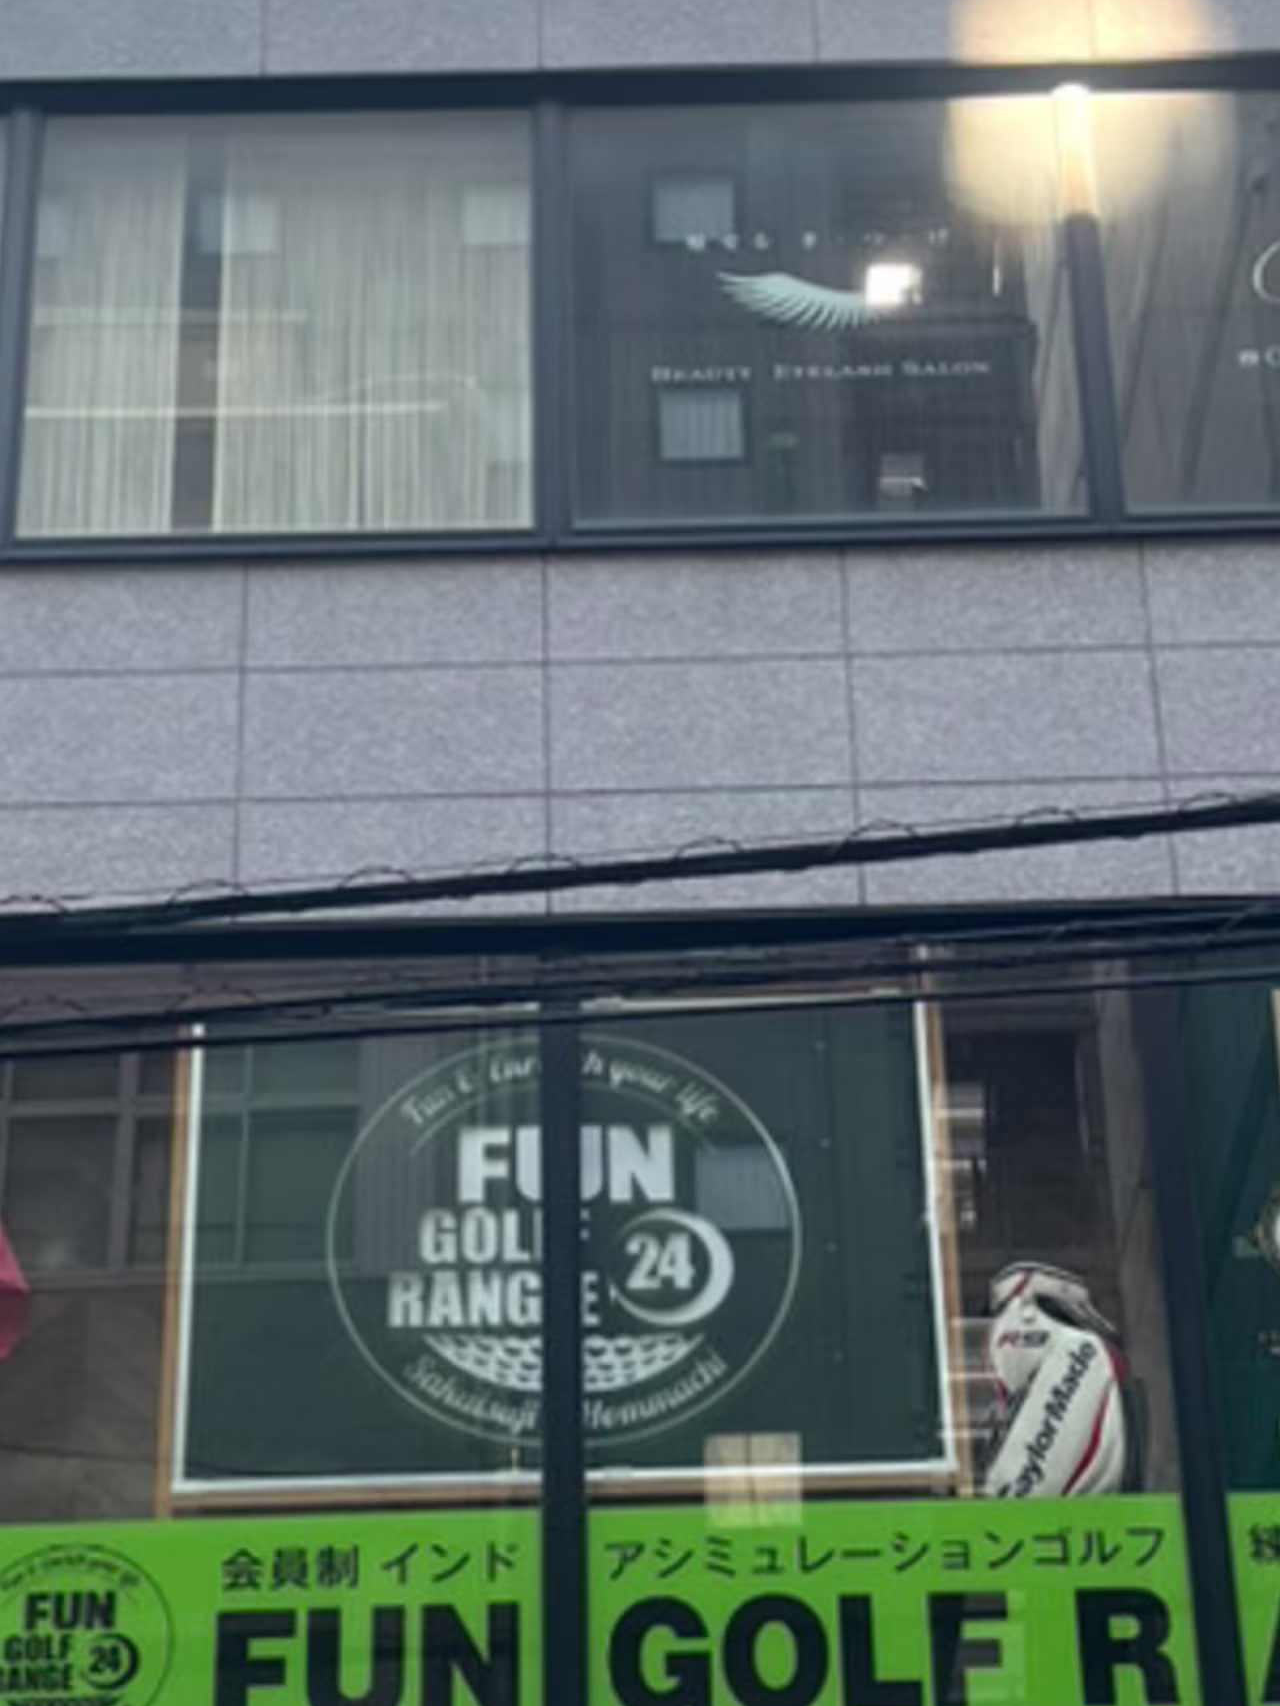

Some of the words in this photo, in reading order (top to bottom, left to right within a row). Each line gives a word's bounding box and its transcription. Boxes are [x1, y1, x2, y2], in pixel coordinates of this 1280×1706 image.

[625, 1234, 696, 1291] 24
[998, 1340, 1098, 1497] aylorMade
[220, 1545, 360, 1592] 会員制
[24, 1589, 117, 1632] FUN
[2, 1633, 74, 1663] GOLF
